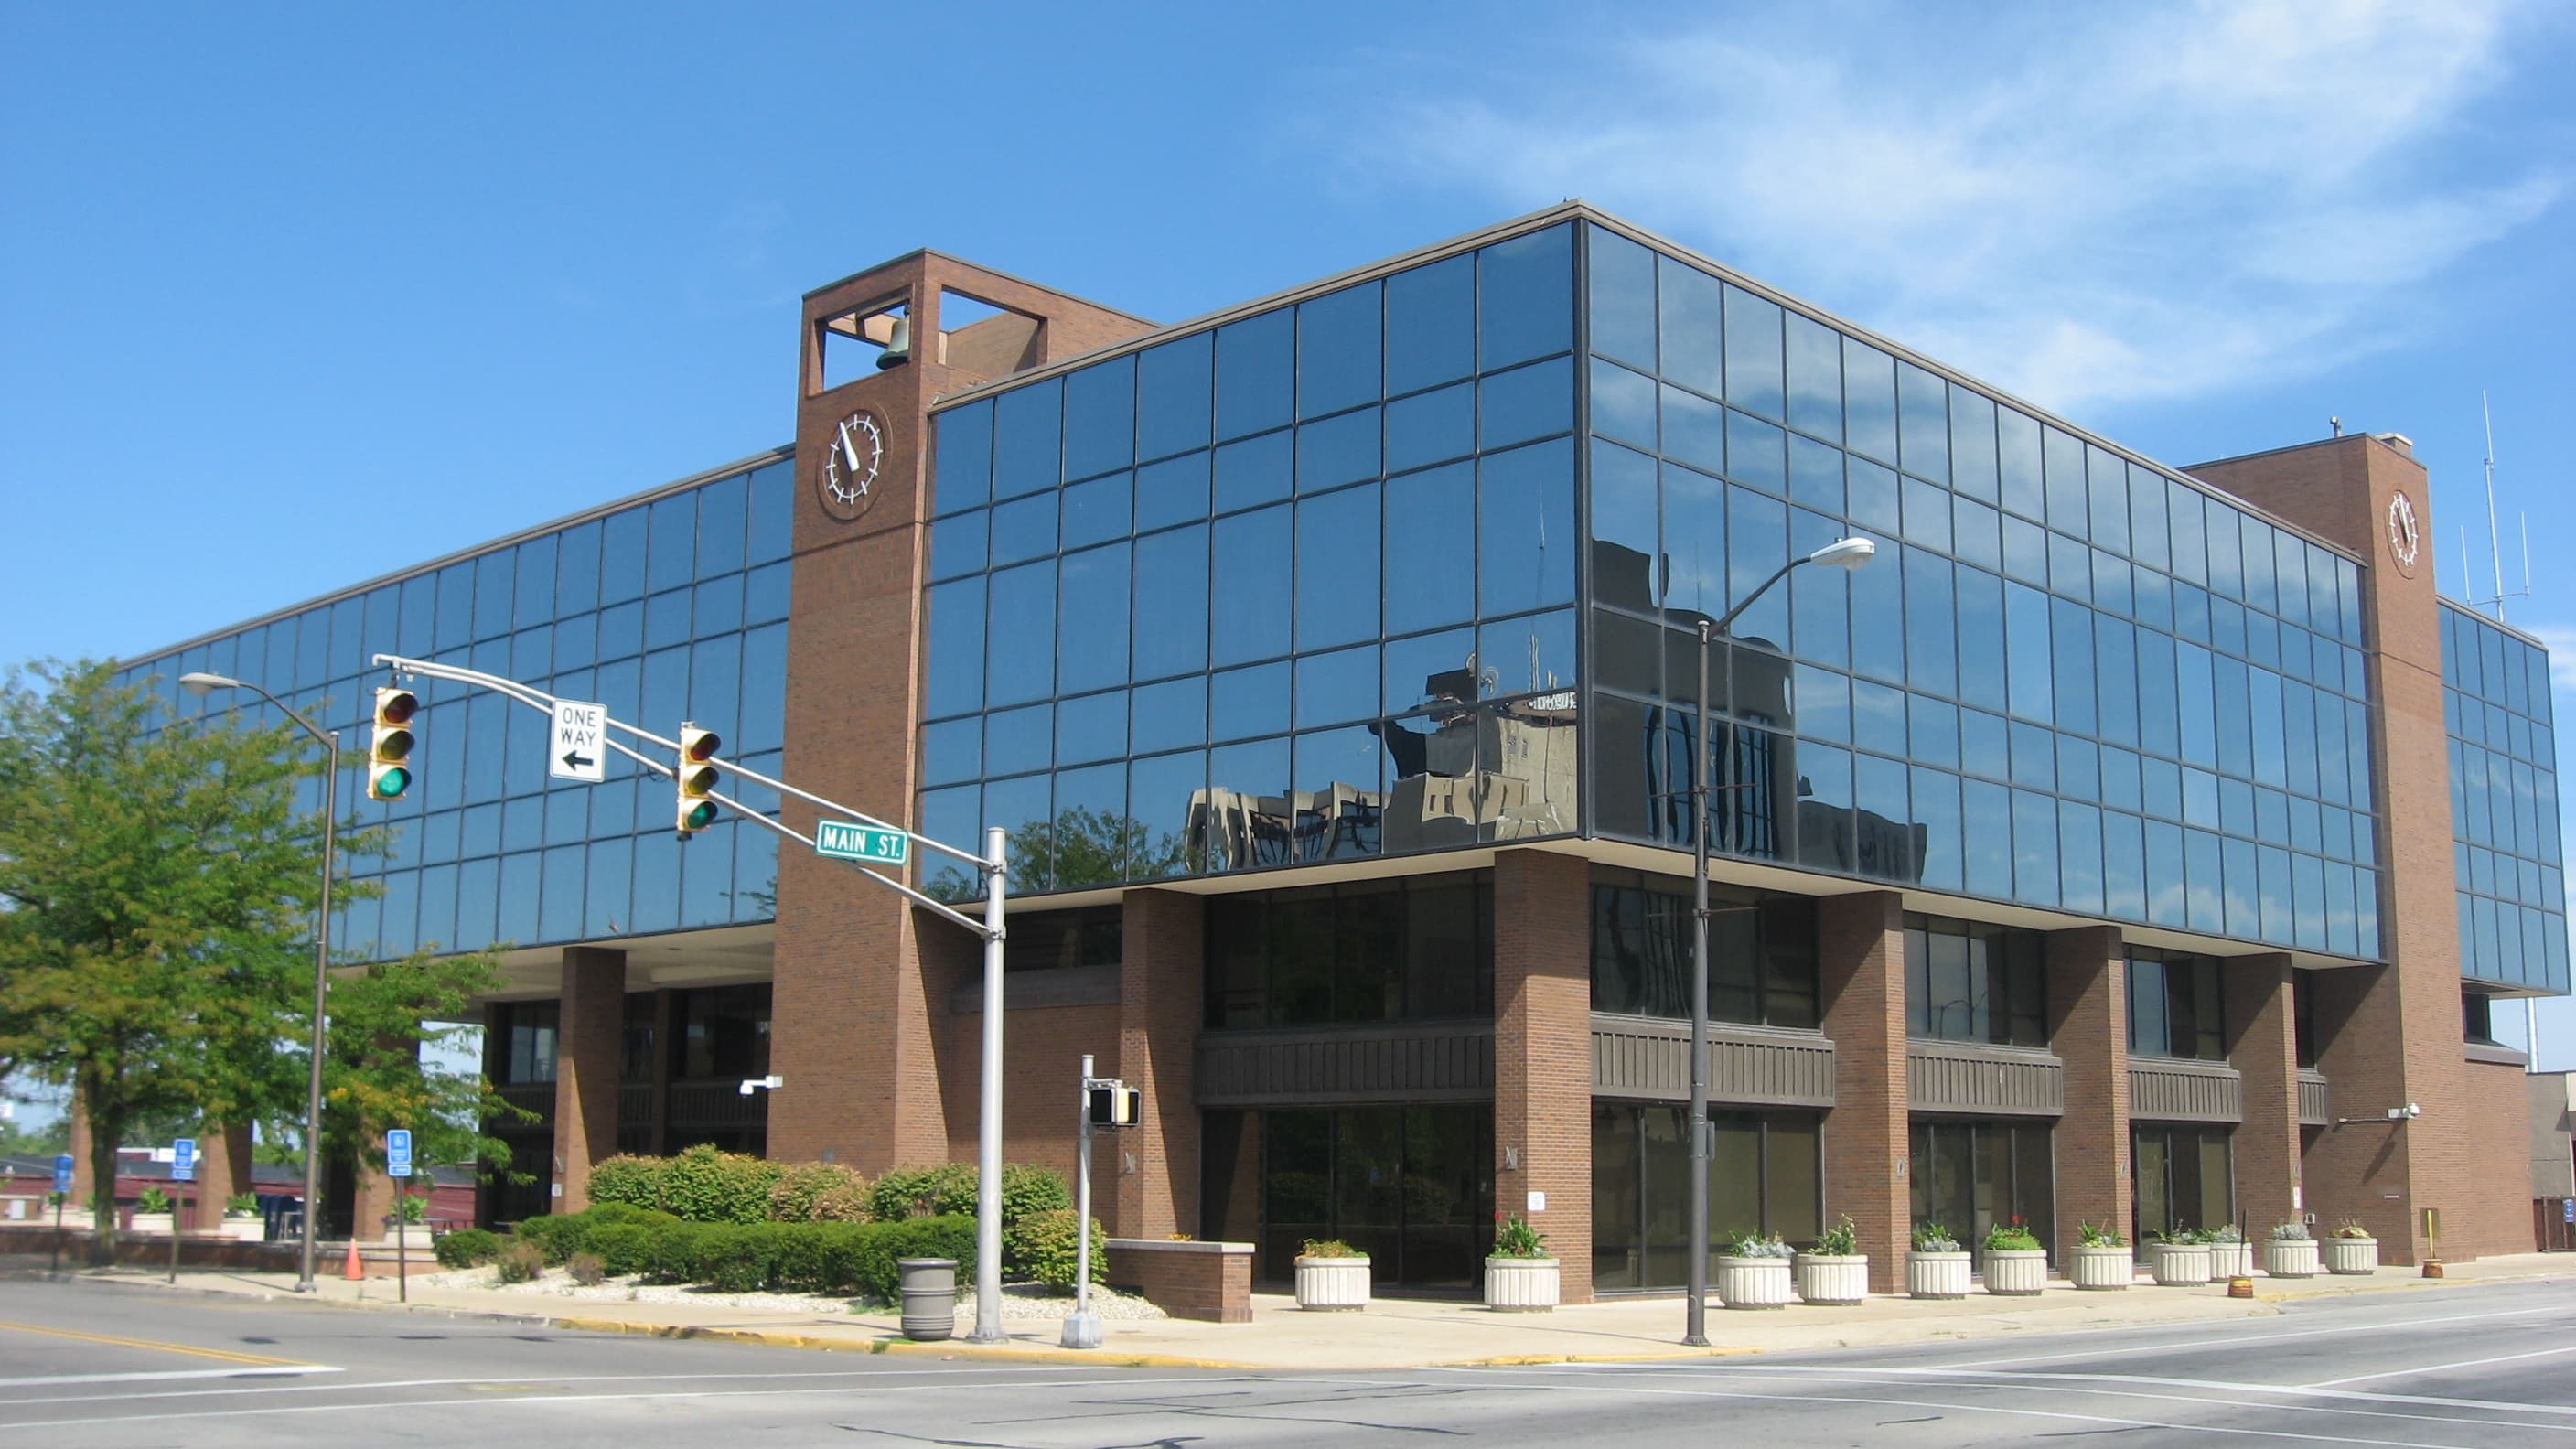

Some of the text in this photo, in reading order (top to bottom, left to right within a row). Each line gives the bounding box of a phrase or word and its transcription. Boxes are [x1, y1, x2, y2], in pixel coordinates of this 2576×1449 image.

[563, 707, 596, 728] ONE
[561, 727, 596, 747] WAY
[823, 826, 900, 857] MAIN ST.
